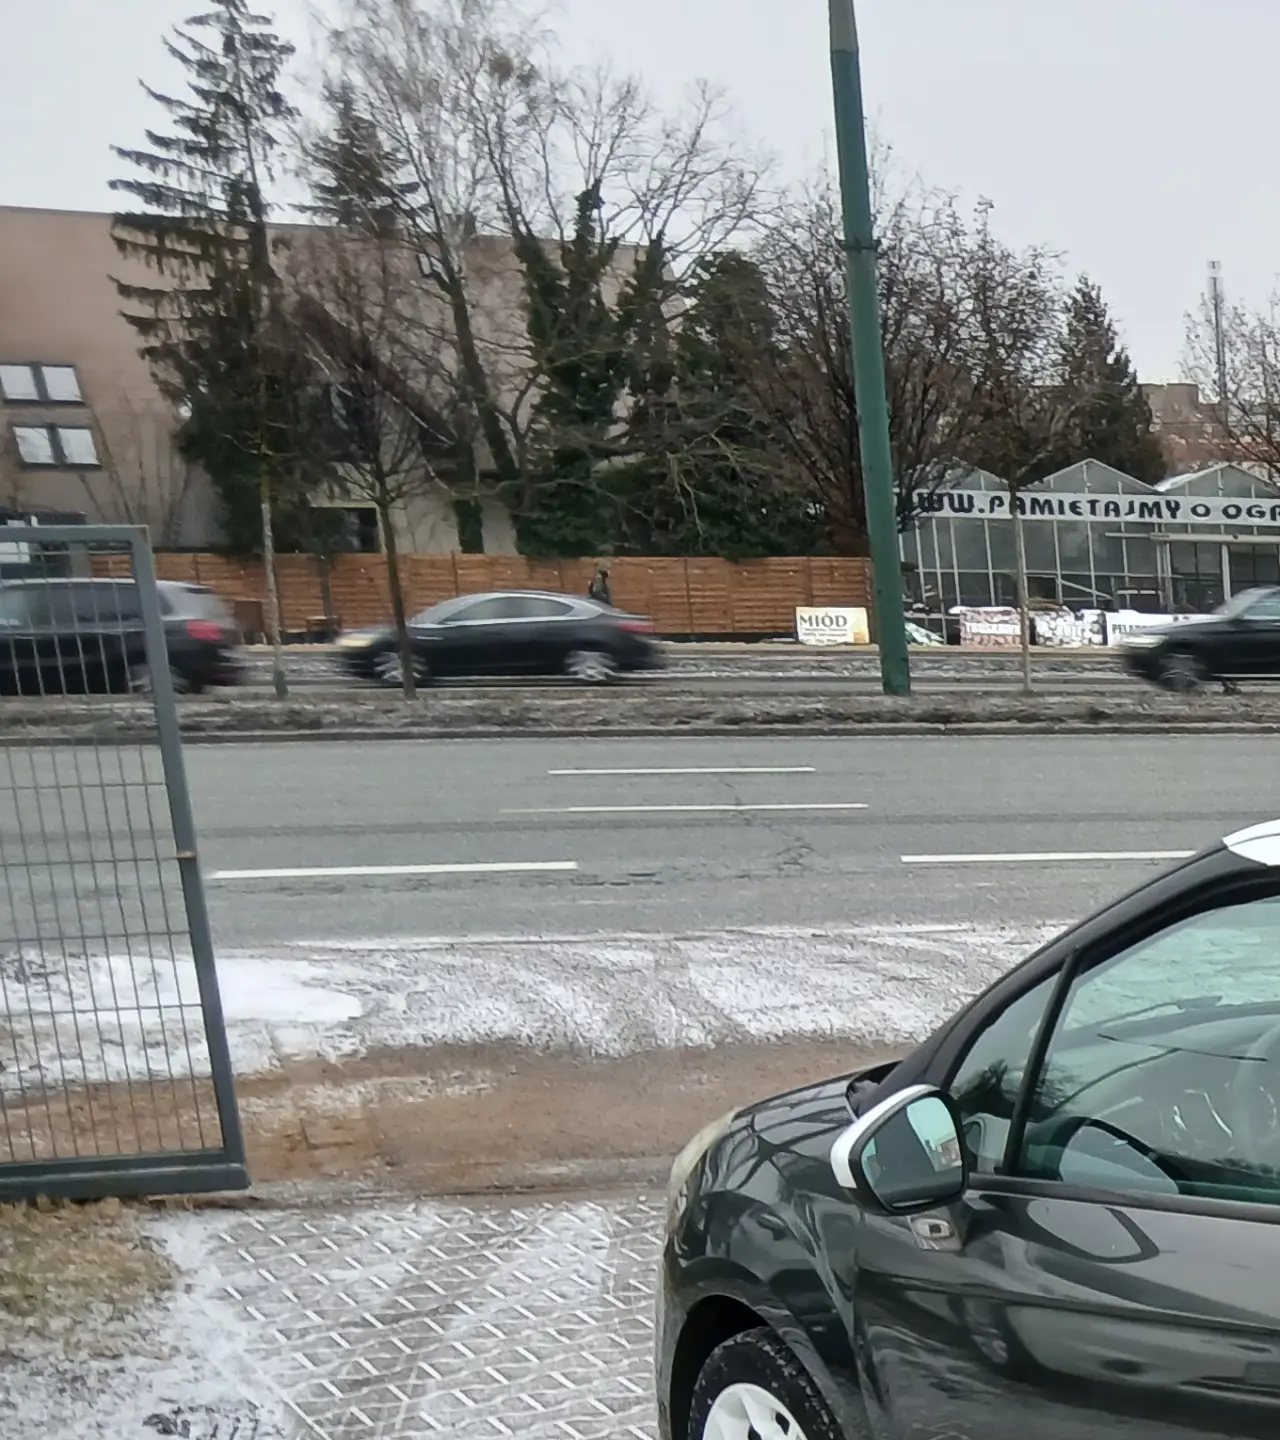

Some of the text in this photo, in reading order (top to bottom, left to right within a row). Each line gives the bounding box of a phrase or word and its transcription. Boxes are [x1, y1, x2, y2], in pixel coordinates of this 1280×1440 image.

[895, 492, 1181, 519] WW.PAMIETAJMY
[1190, 502, 1211, 520] O
[799, 612, 848, 628] MIÓD
